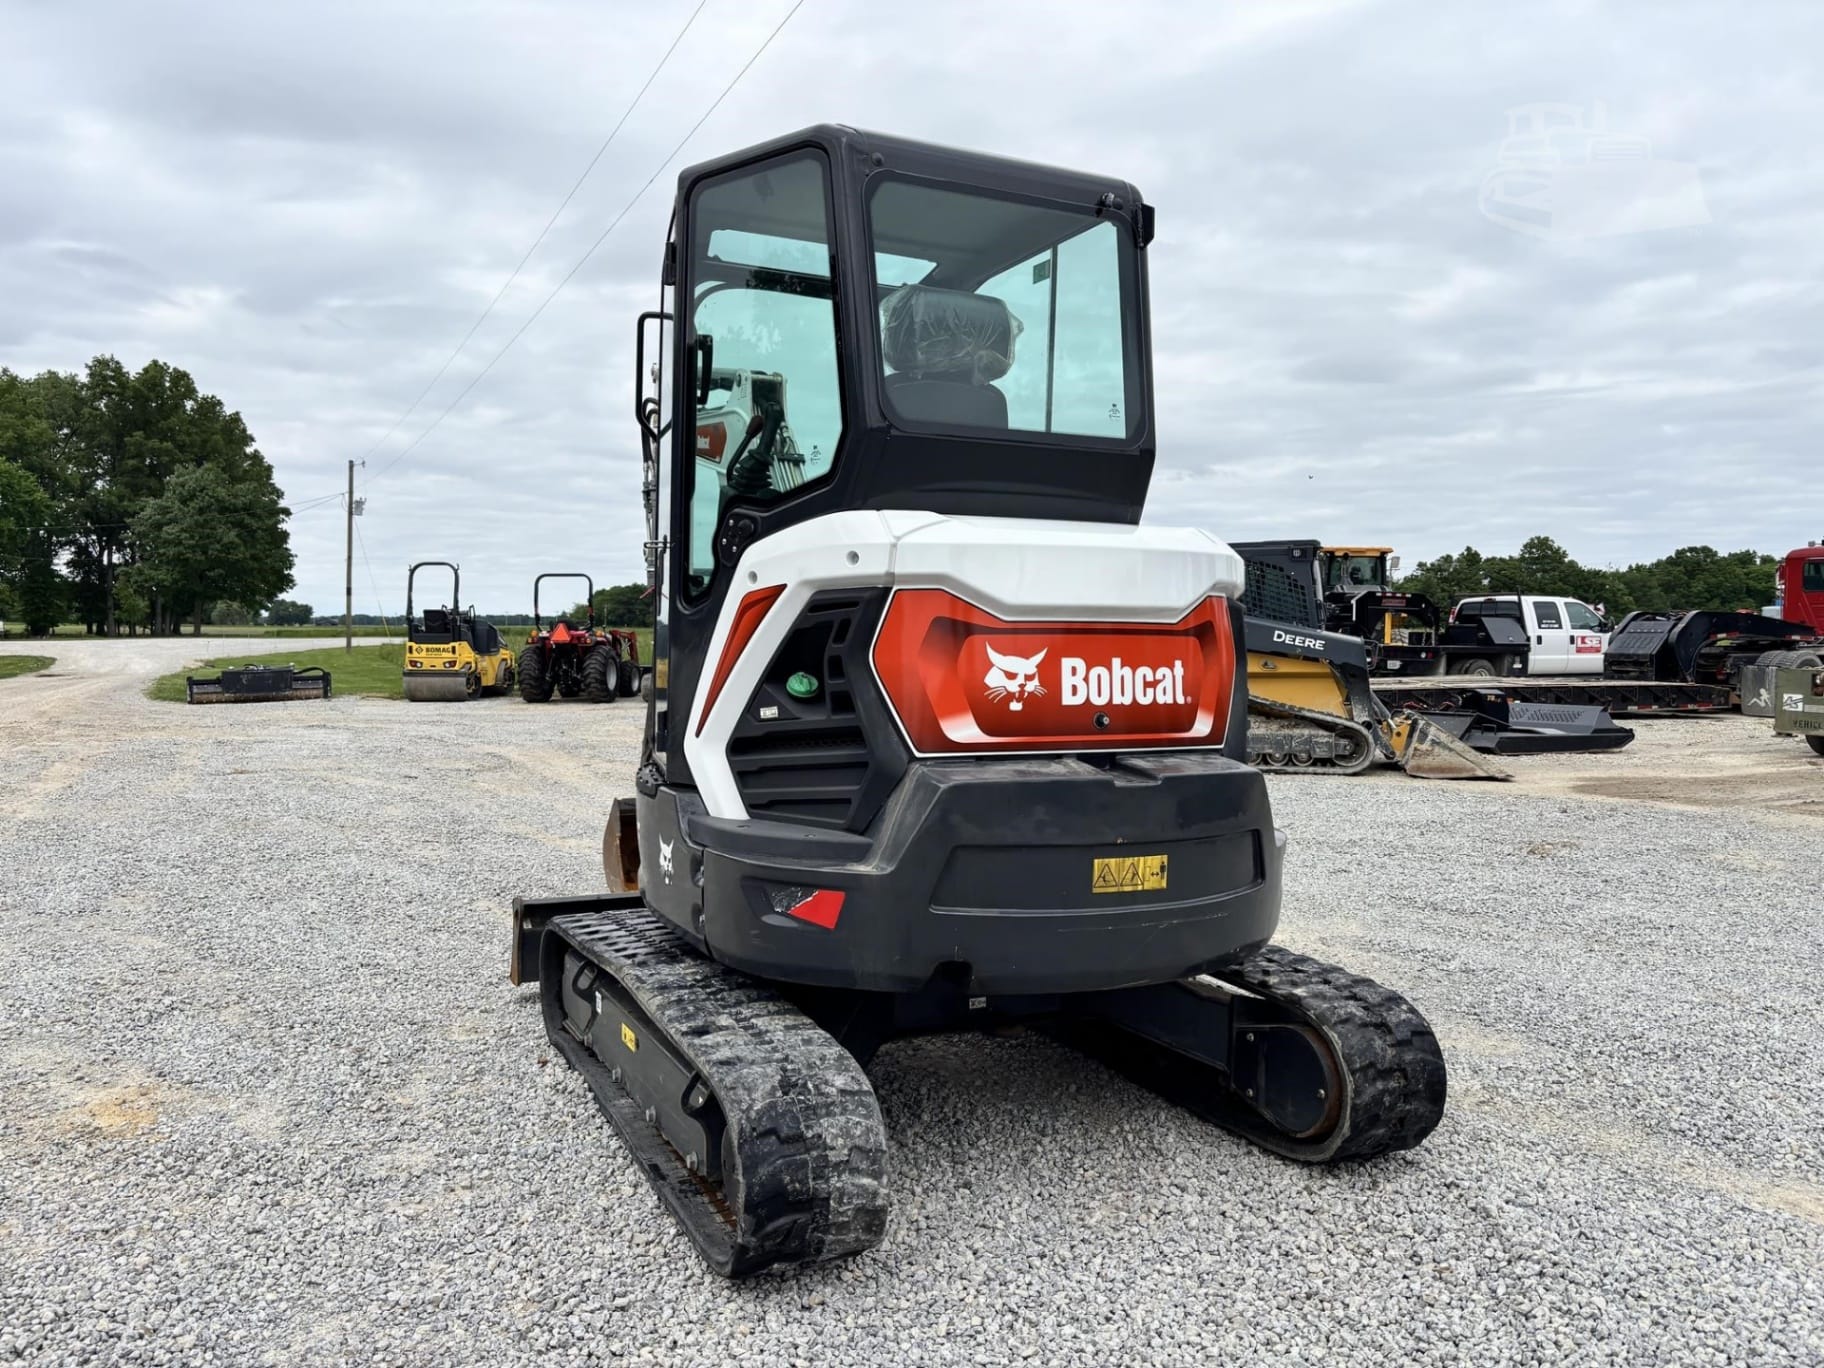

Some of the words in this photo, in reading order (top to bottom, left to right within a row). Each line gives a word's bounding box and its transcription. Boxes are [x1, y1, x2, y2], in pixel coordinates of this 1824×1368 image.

[425, 646, 451, 654] BOMAG
[1273, 630, 1326, 650] DEERE
[1061, 657, 1186, 706] Bobcat
